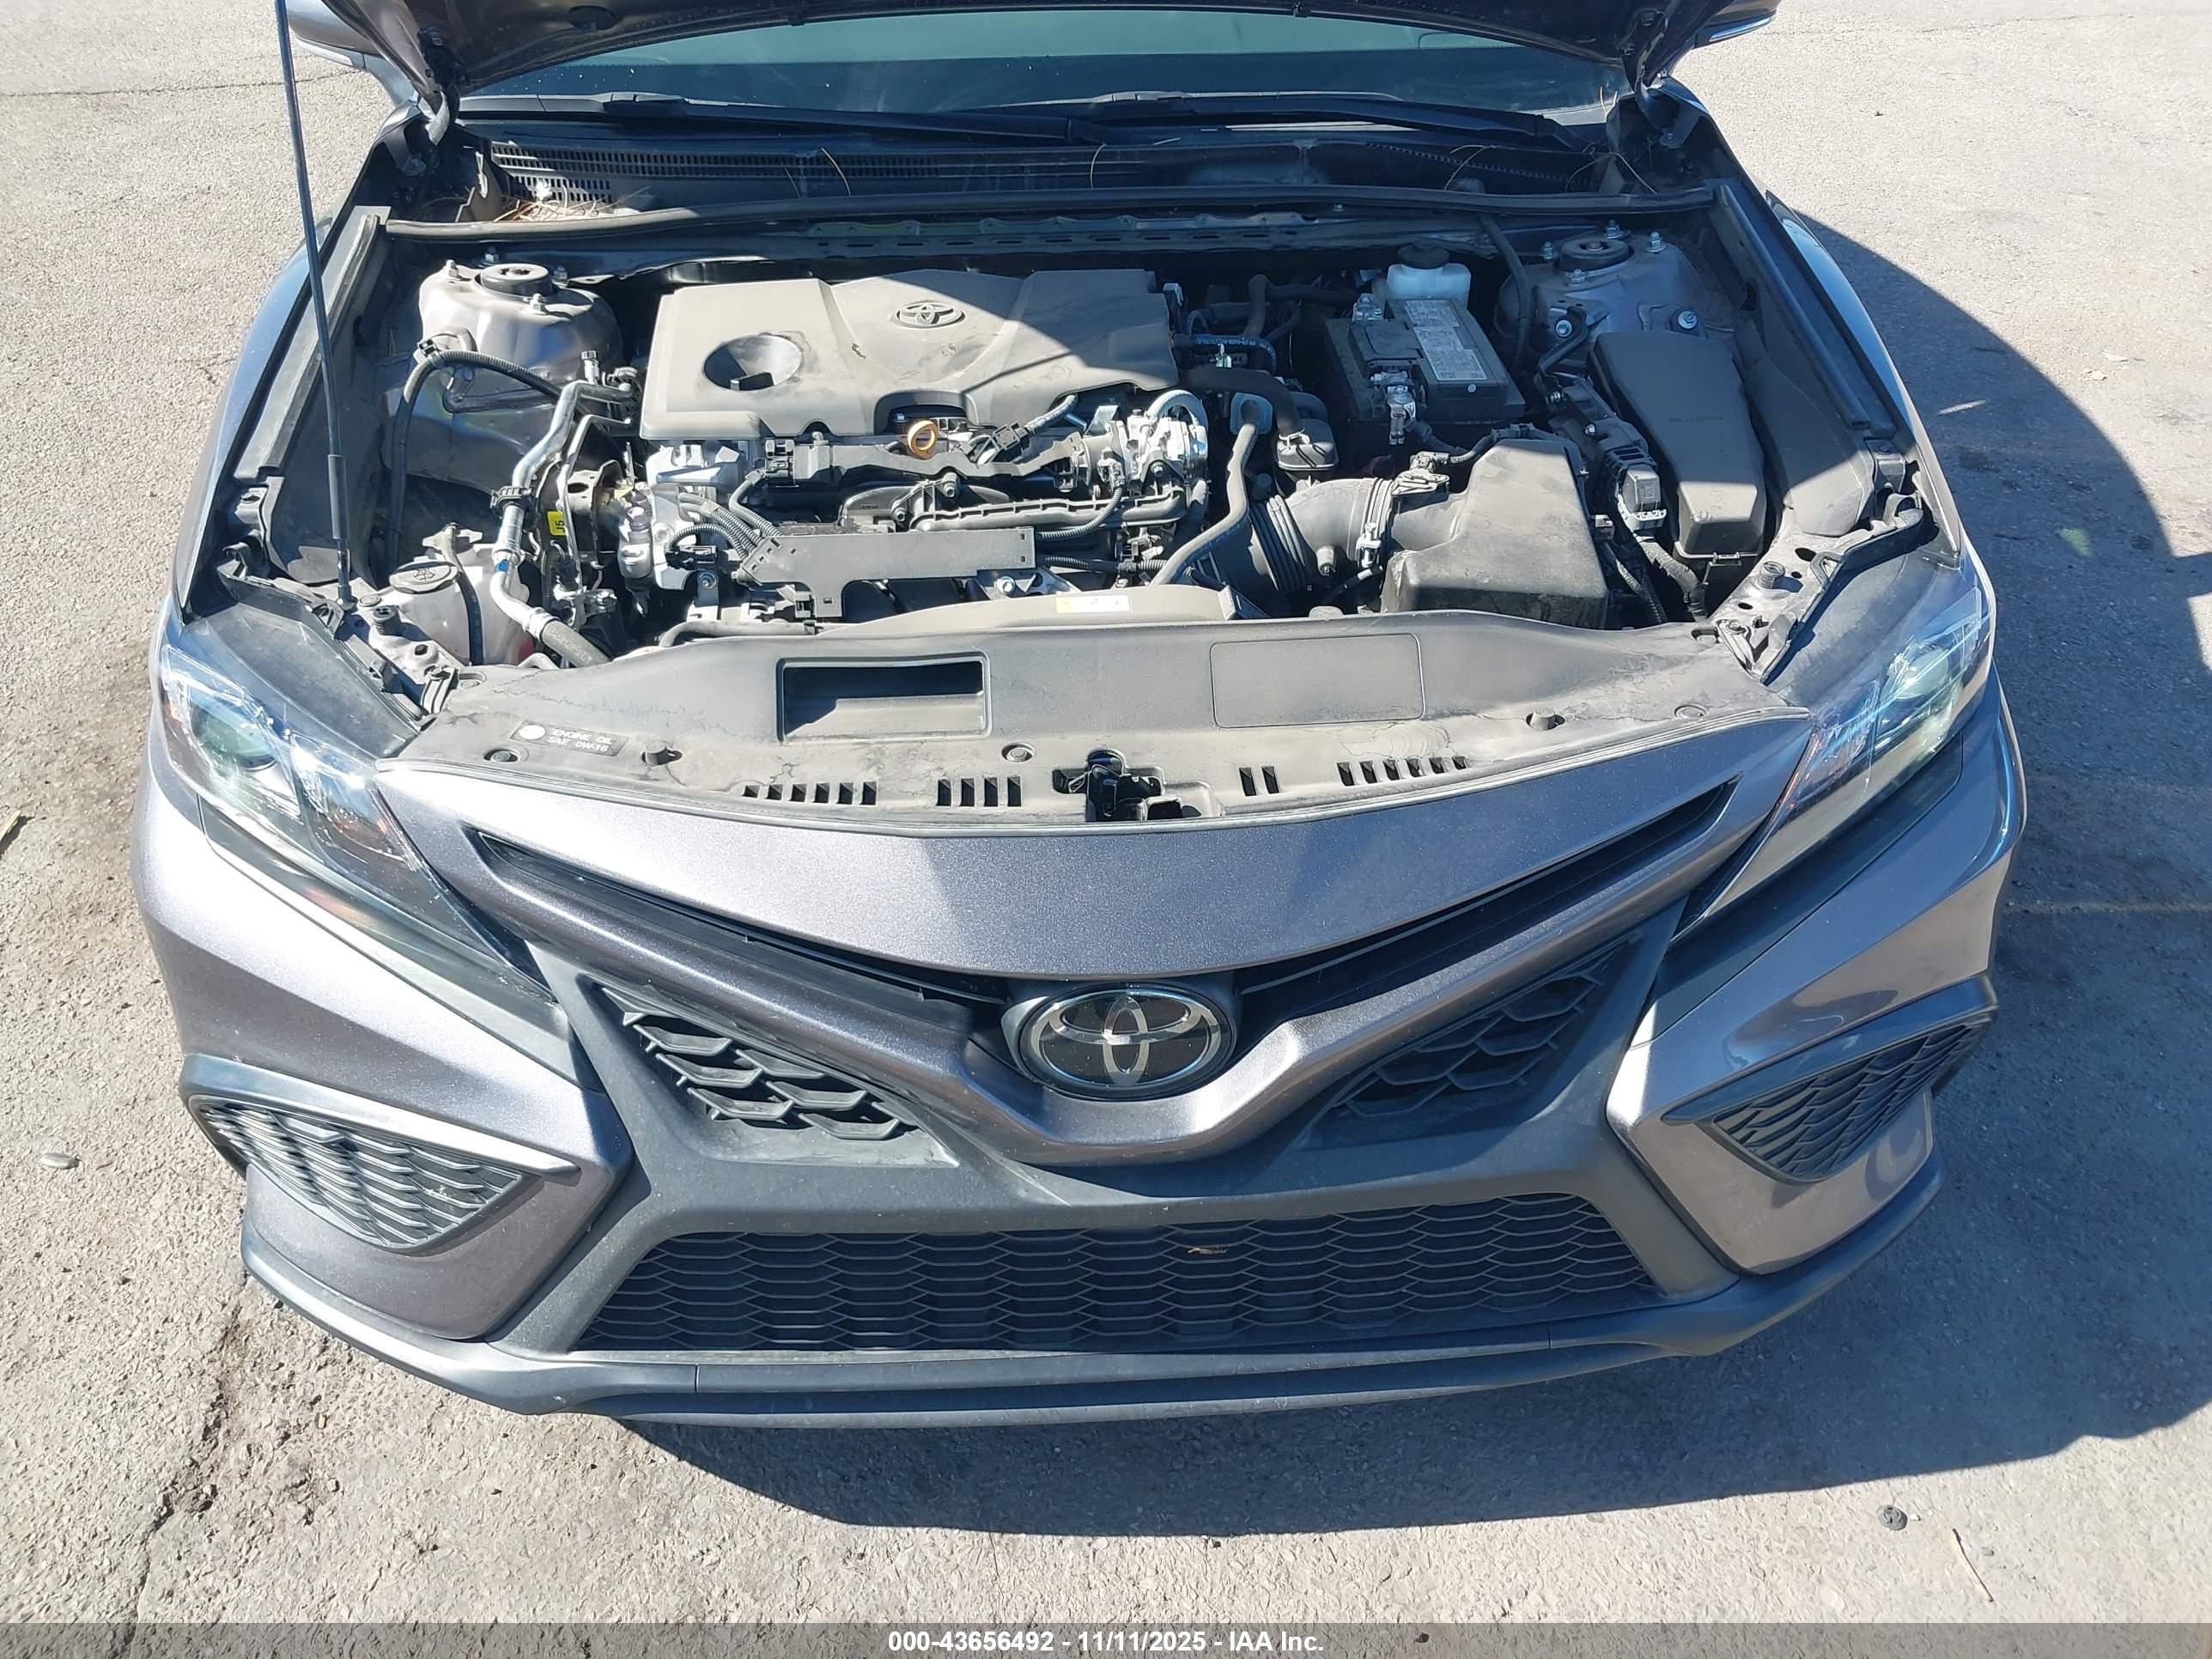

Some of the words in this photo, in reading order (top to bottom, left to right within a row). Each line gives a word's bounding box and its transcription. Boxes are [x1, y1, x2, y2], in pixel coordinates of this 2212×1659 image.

[546, 736, 571, 745] SAE
[552, 729, 592, 741] ENGINE
[596, 735, 612, 745] OIL
